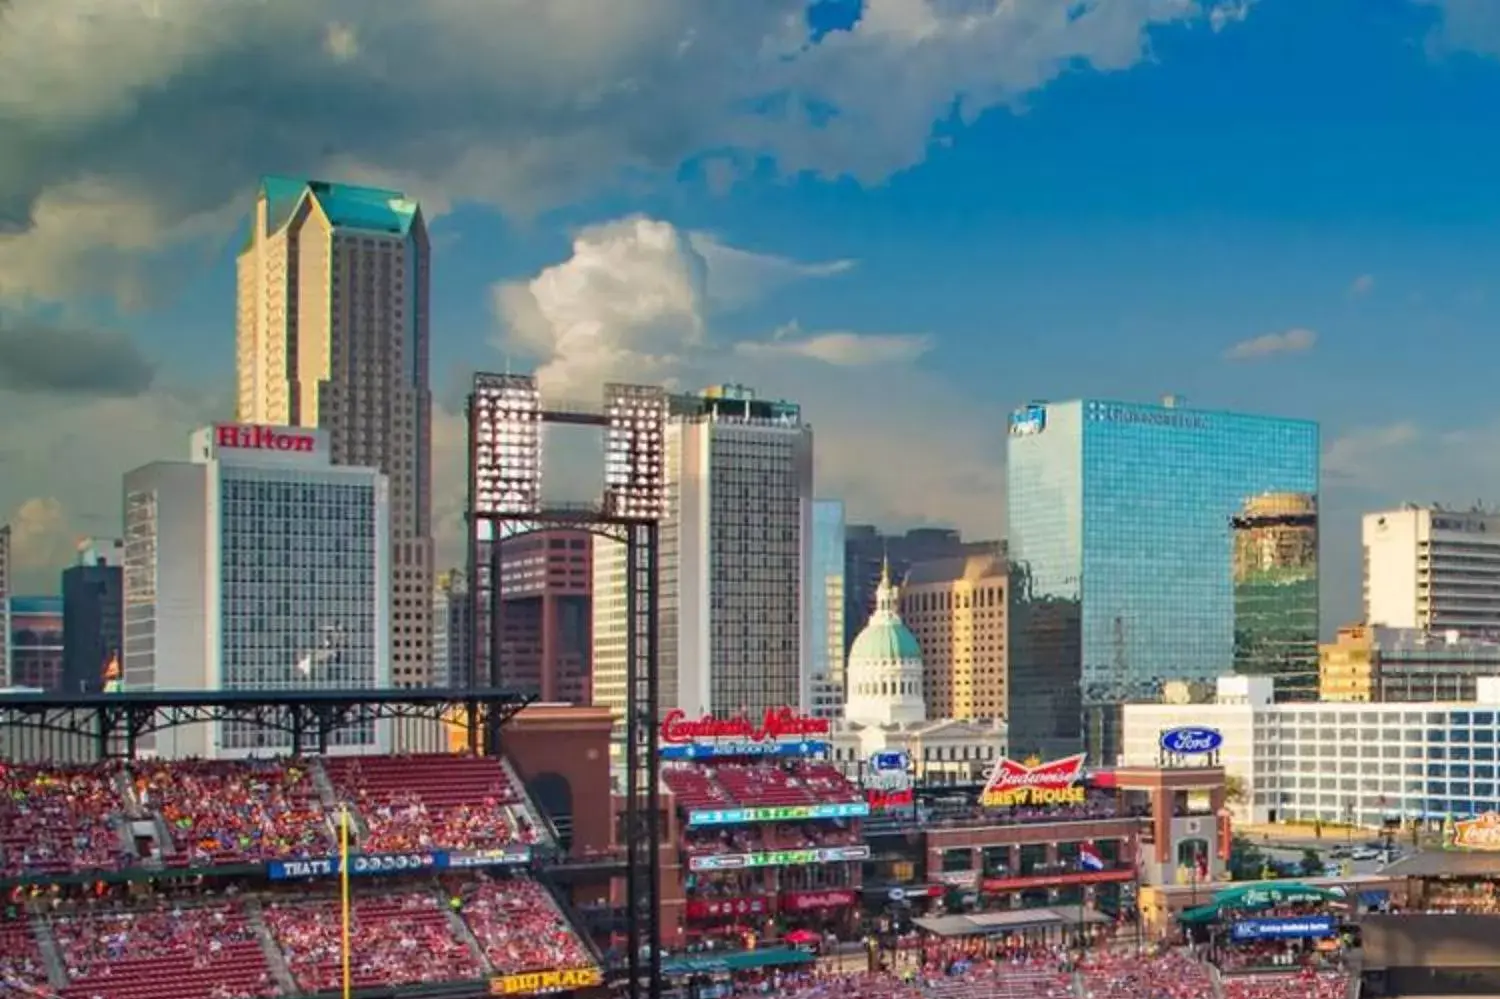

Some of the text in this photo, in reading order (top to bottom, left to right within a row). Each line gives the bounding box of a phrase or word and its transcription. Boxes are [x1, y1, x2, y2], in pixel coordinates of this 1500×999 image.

[215, 424, 317, 453] Hilton
[1173, 732, 1213, 749] Ford
[994, 766, 1077, 788] Budweiser
[985, 786, 1086, 807] BREW HOUSE
[284, 860, 331, 876] THAT'S
[542, 970, 591, 986] MAC
